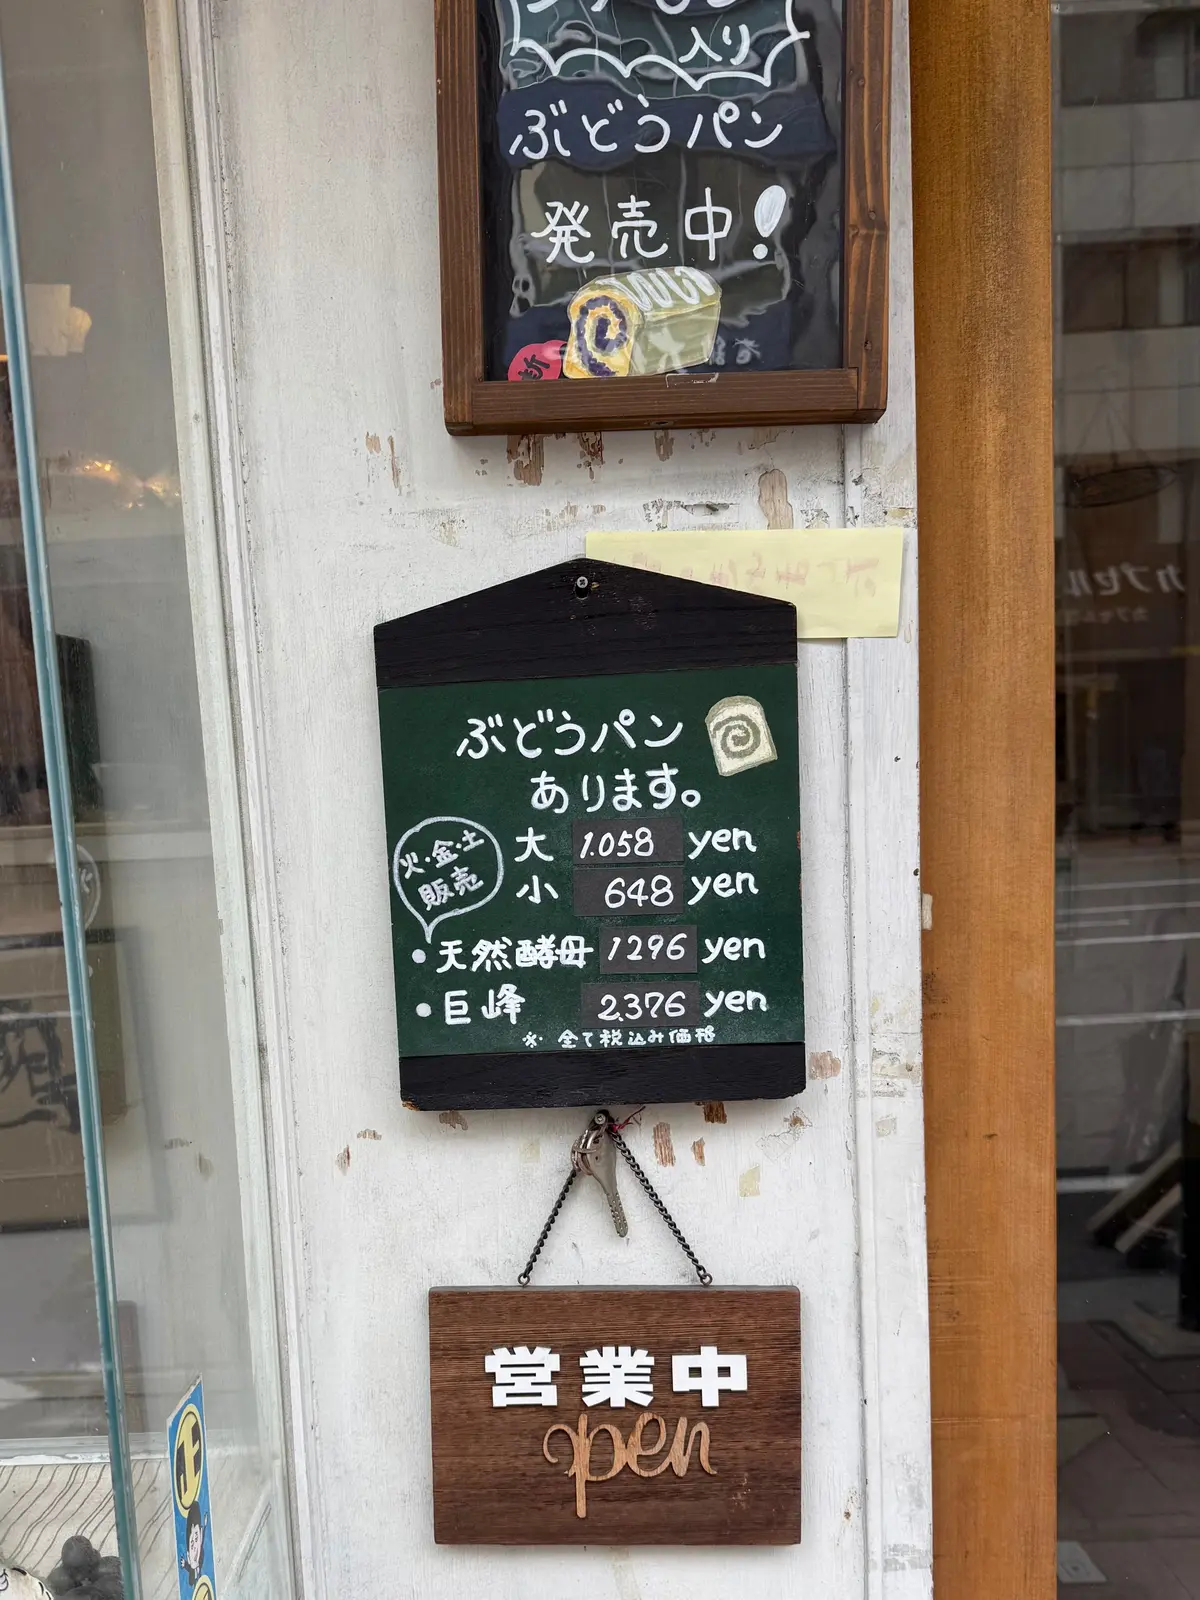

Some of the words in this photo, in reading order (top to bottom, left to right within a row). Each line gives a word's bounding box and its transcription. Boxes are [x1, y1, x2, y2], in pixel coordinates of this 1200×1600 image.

[509, 94, 782, 159] ぶどうパン
[457, 709, 683, 759] ぶどうパン
[531, 763, 700, 813] あります。
[515, 827, 554, 861] 大
[688, 828, 756, 859] yen
[417, 866, 484, 911] 販売
[516, 875, 558, 904] 小
[605, 875, 673, 908] 648
[688, 872, 758, 905] yen
[436, 934, 594, 973] 天然酵母
[608, 933, 687, 960] 1296
[702, 937, 765, 963] yen
[445, 984, 525, 1025] 巨峰
[704, 990, 767, 1017] yen
[485, 1347, 747, 1406] 営業中
